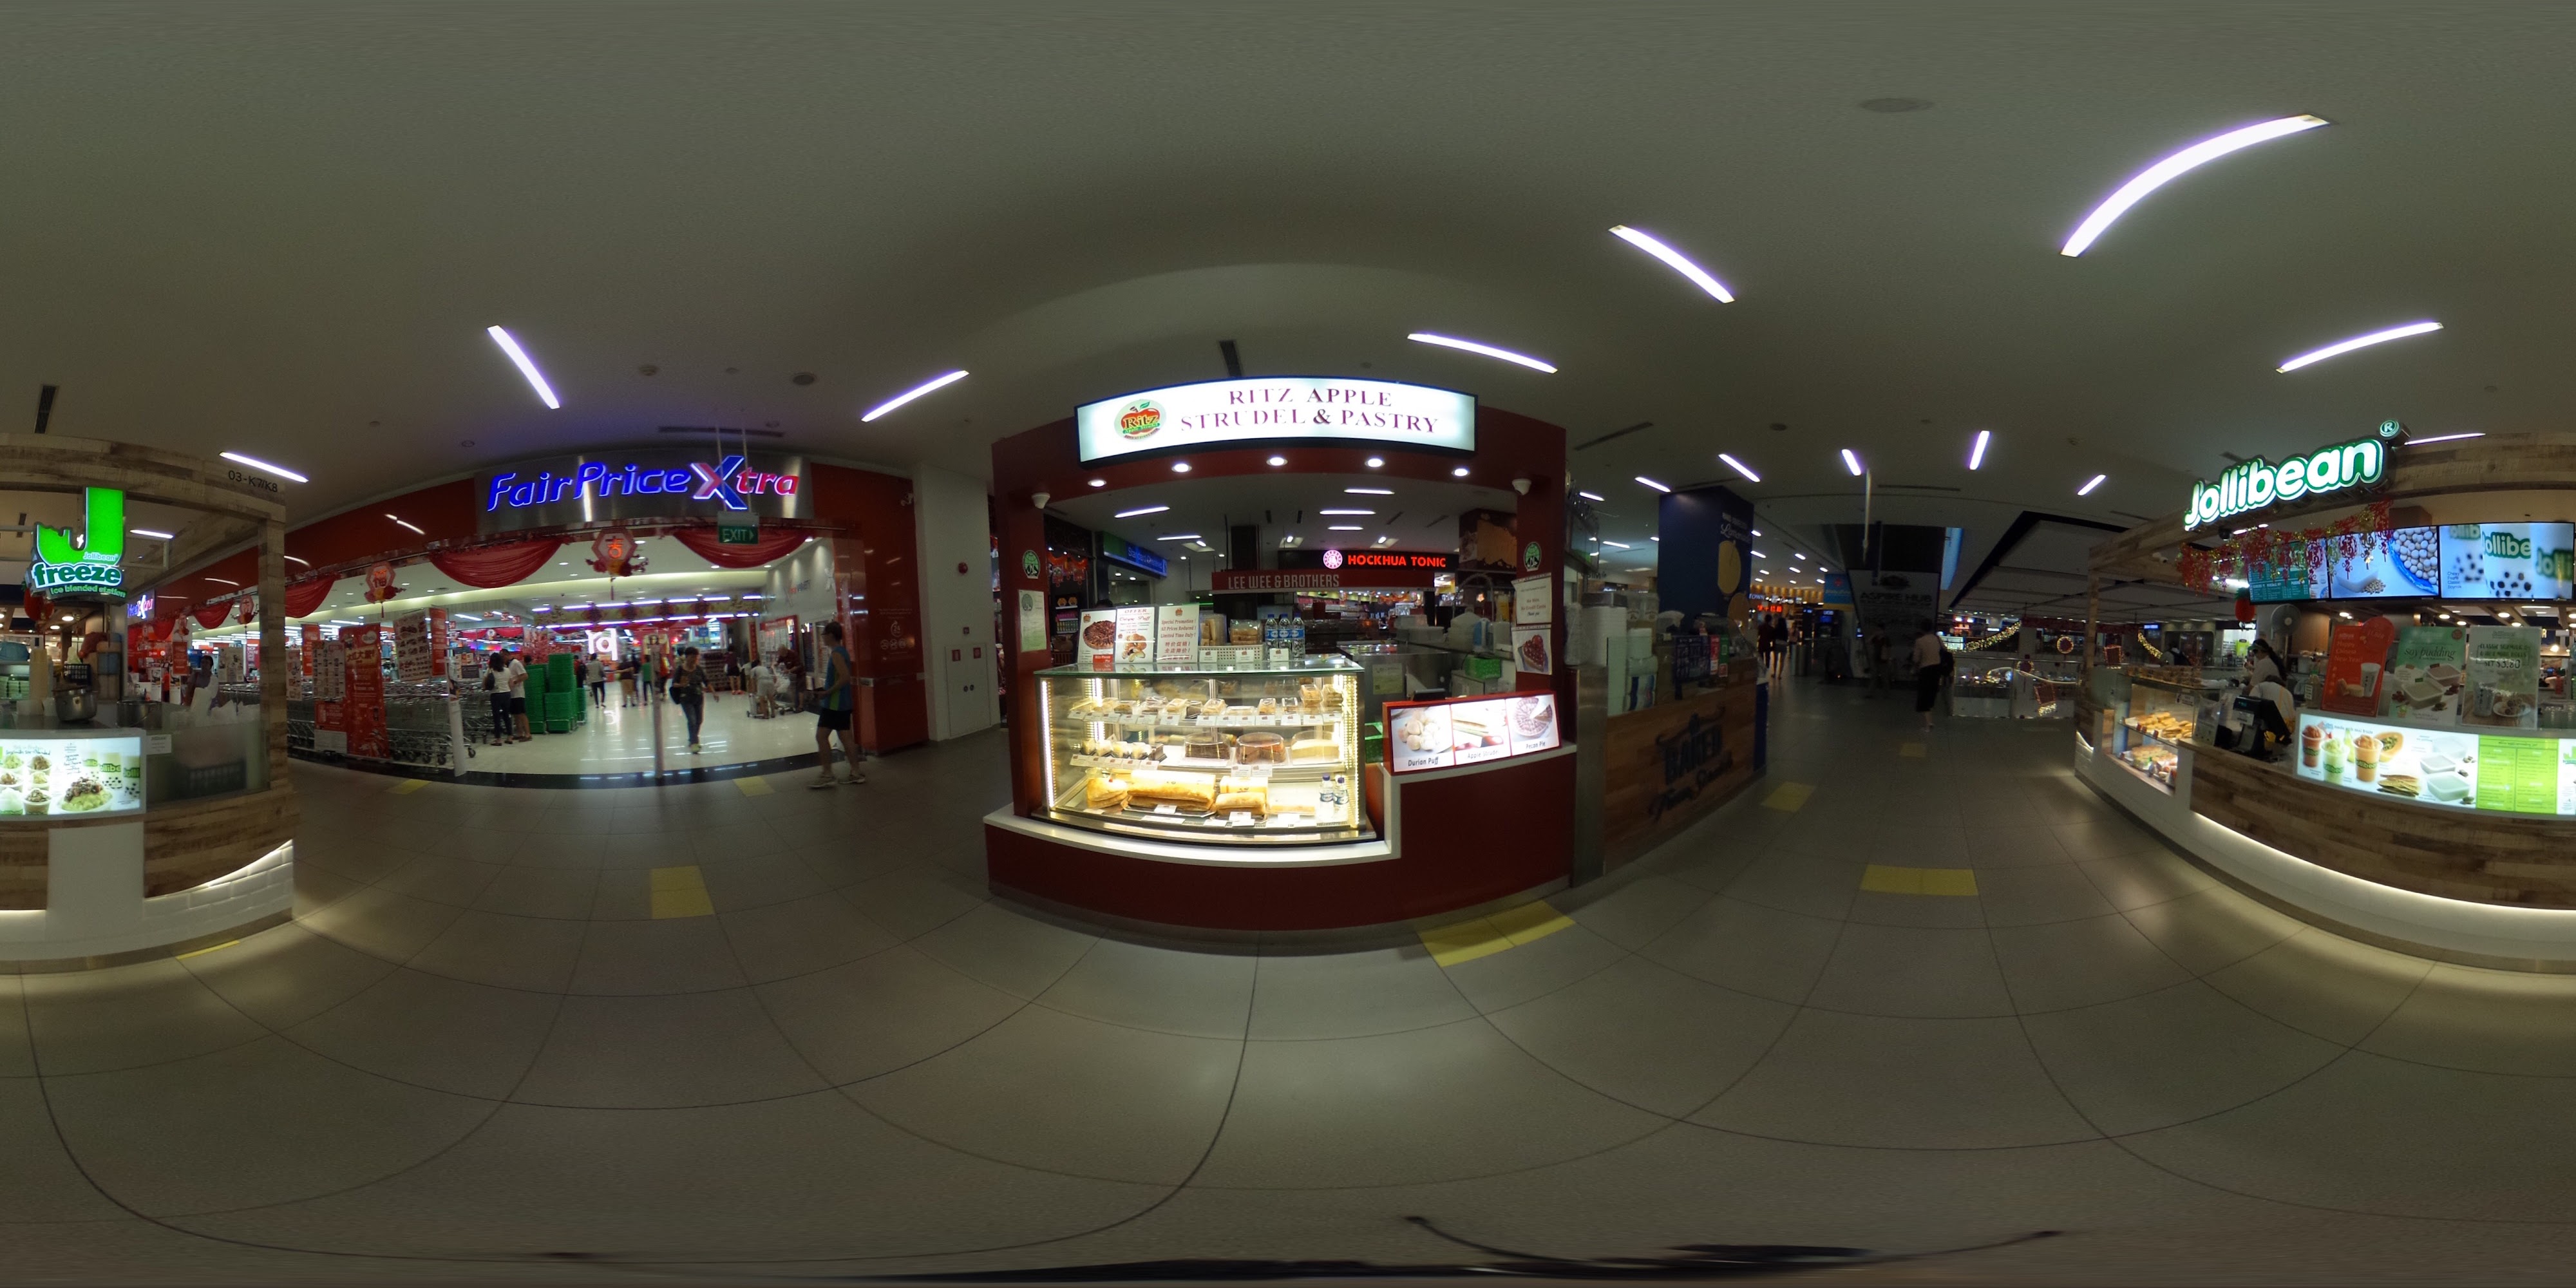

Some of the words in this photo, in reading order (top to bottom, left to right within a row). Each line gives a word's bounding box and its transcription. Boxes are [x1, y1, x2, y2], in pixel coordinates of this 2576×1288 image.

[1228, 388, 1293, 405] RITZ
[1307, 388, 1392, 407] APPLE
[1123, 415, 1159, 429] Ritz
[1180, 409, 1305, 431] STRUDEL
[1312, 408, 1331, 425] &
[1341, 410, 1439, 433] PASTRY
[228, 470, 278, 492] 03-K7/K8
[488, 461, 690, 512] FairPrice
[690, 455, 800, 510] Xtra
[2184, 439, 2382, 529] Jollibean
[722, 529, 747, 542] EXIT
[1720, 523, 1751, 544] Lemon
[83, 552, 116, 562] Jollibean
[1348, 554, 1406, 566] HOCKHUA
[1410, 556, 1446, 567] TONIC
[33, 564, 121, 586] freeze
[1228, 576, 1245, 590] LEE
[1249, 575, 1271, 589] WEE
[1274, 575, 1282, 589] &
[1283, 574, 1340, 588] BROTHERS
[99, 587, 126, 598] station
[2404, 648, 2418, 658] soy
[2420, 647, 2456, 661] pudding
[1408, 758, 1426, 767] Durian
[1427, 756, 1439, 765] Puff
[1467, 751, 1482, 759] Apple
